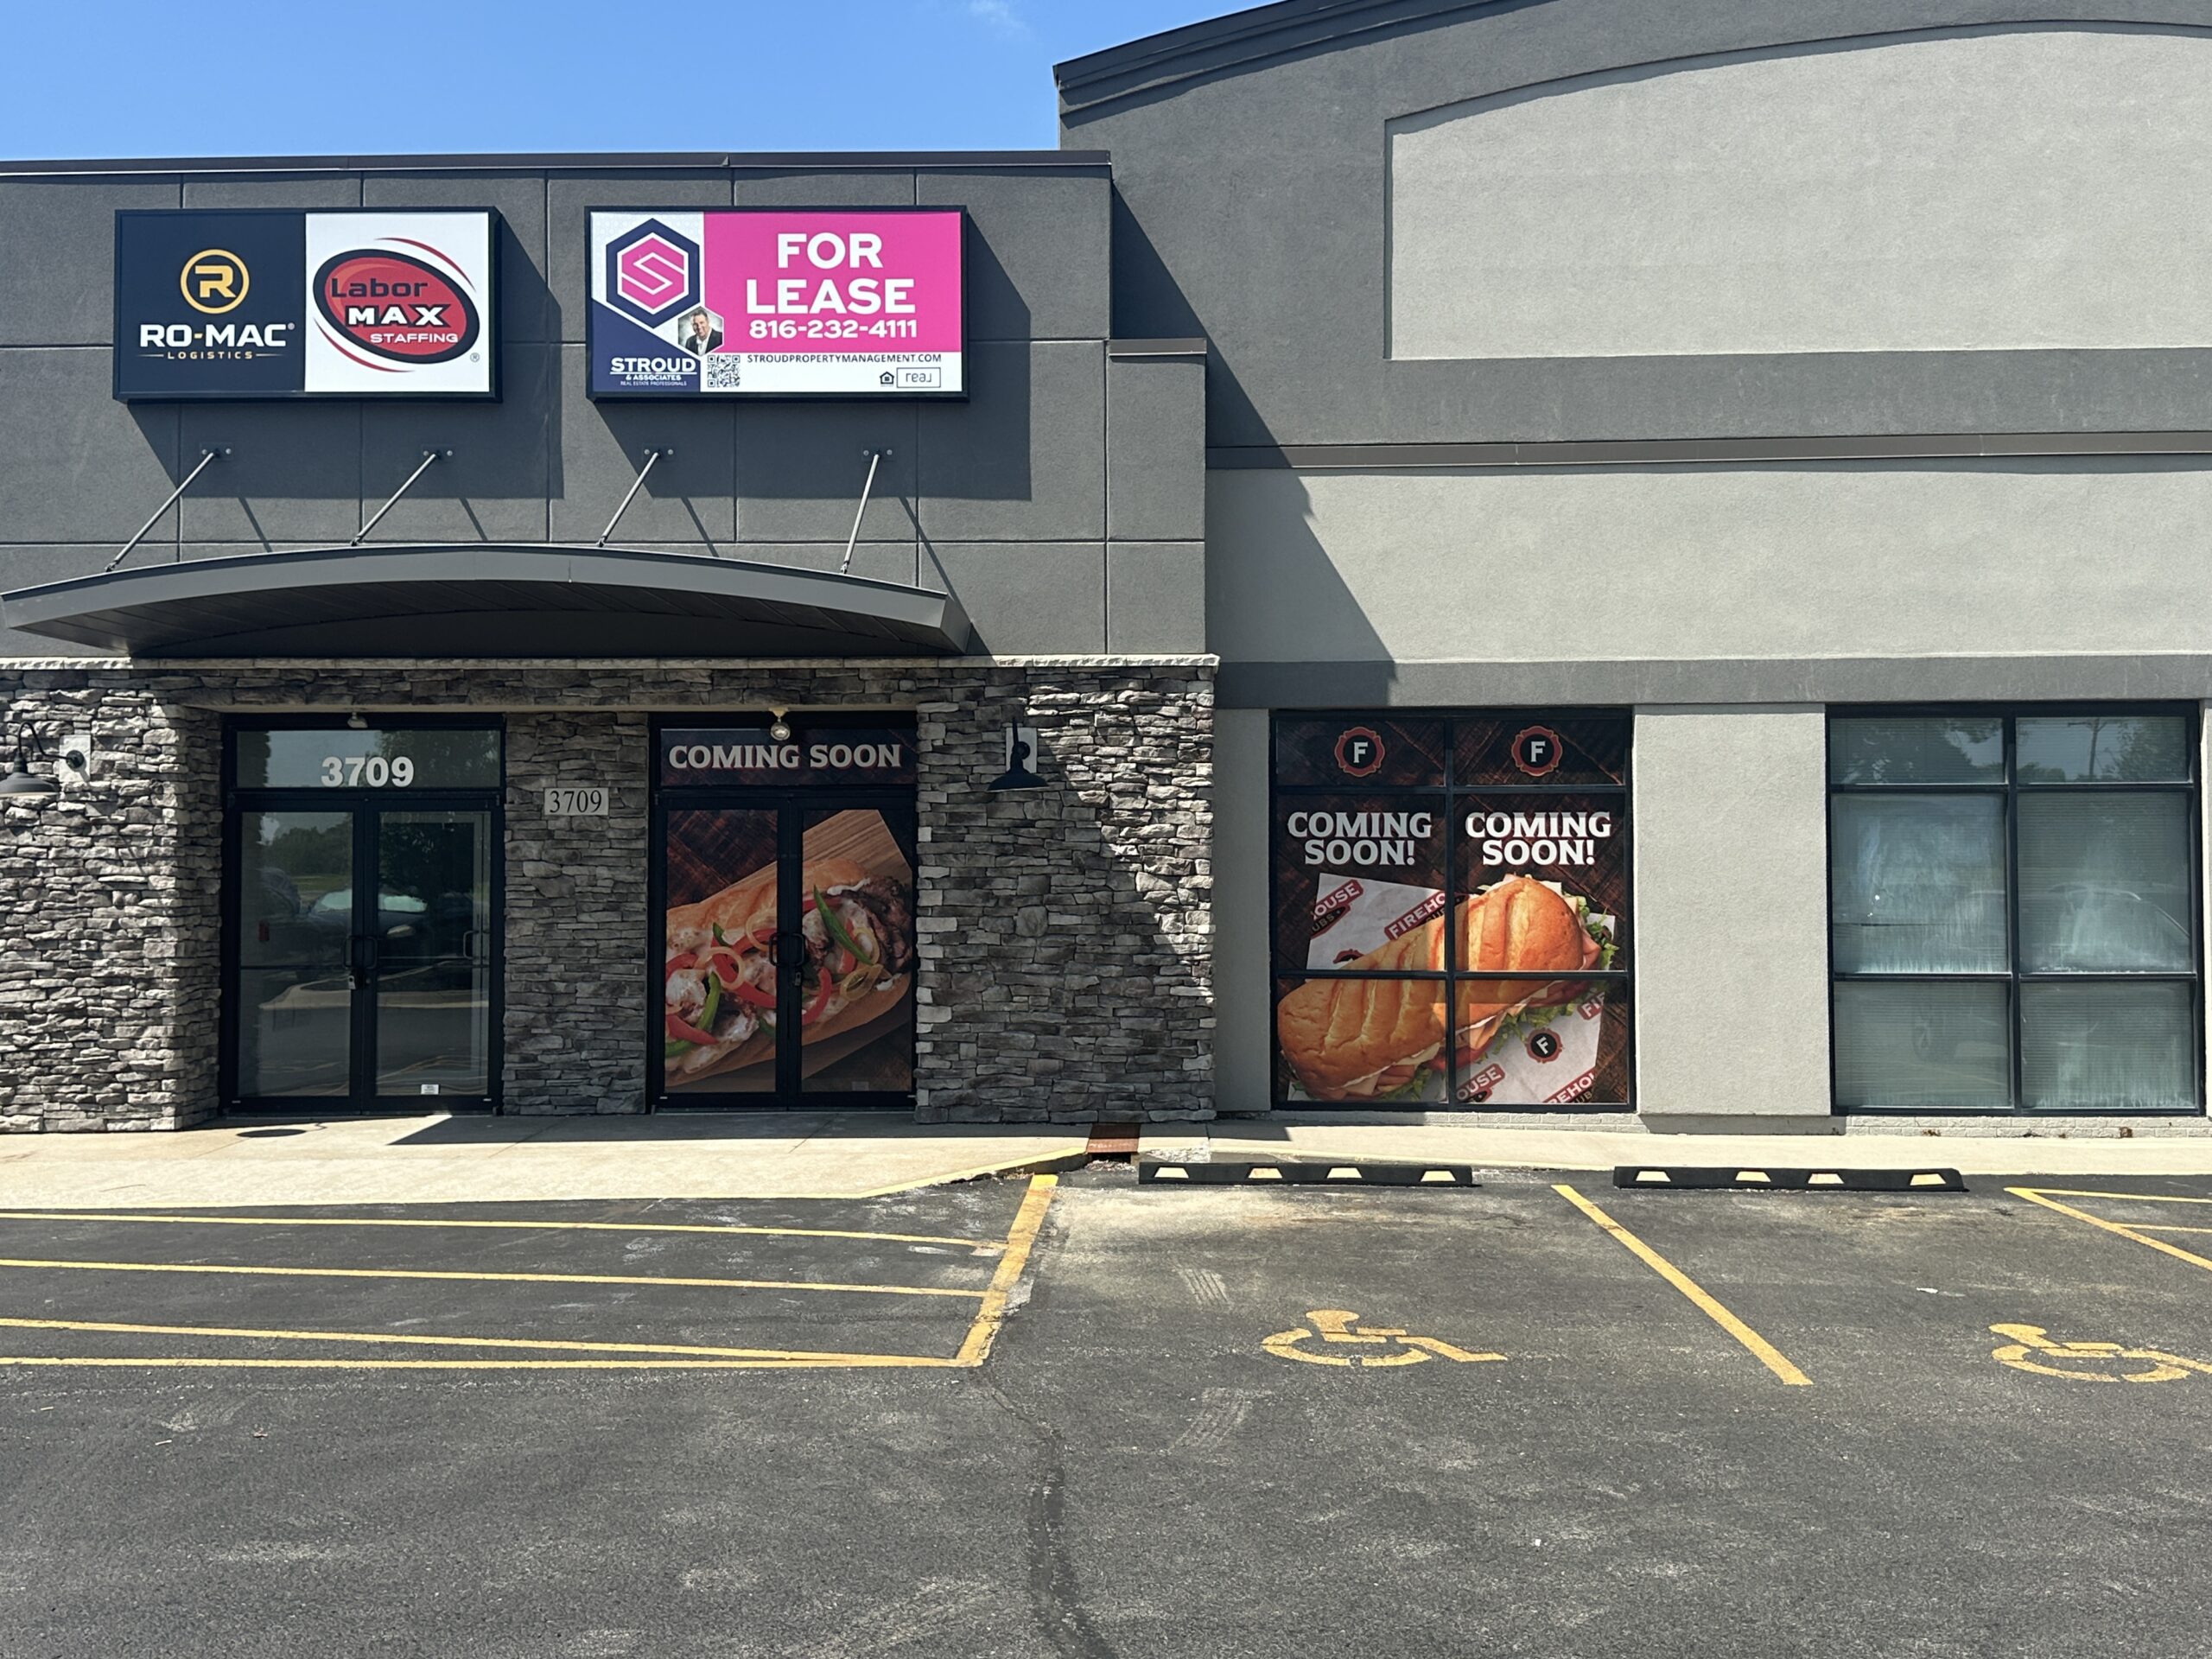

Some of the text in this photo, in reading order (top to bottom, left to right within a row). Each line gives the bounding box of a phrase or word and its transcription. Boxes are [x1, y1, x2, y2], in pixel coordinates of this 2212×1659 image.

[777, 232, 884, 270] FOR
[331, 277, 429, 298] Labor
[746, 277, 916, 315] LEASE
[345, 303, 450, 327] MAX
[140, 323, 287, 347] RO-MAC
[370, 333, 460, 344] STAFFING
[748, 319, 918, 340] 816-232-4111
[167, 351, 253, 360] LOGISTICS
[610, 357, 696, 372] STROUD
[747, 353, 943, 363] STROUDPROPERTYMANAGEMENT.COM
[668, 744, 902, 768] COMING SOON
[1352, 741, 1370, 764] F
[1530, 741, 1546, 763] F
[321, 755, 415, 787] 3709
[549, 790, 603, 813] 3709
[1287, 811, 1433, 838] COMING
[1465, 811, 1612, 838] COMING
[1304, 839, 1415, 866] SOON!
[1482, 839, 1596, 866] SOON!
[1310, 882, 1361, 920] OUSE
